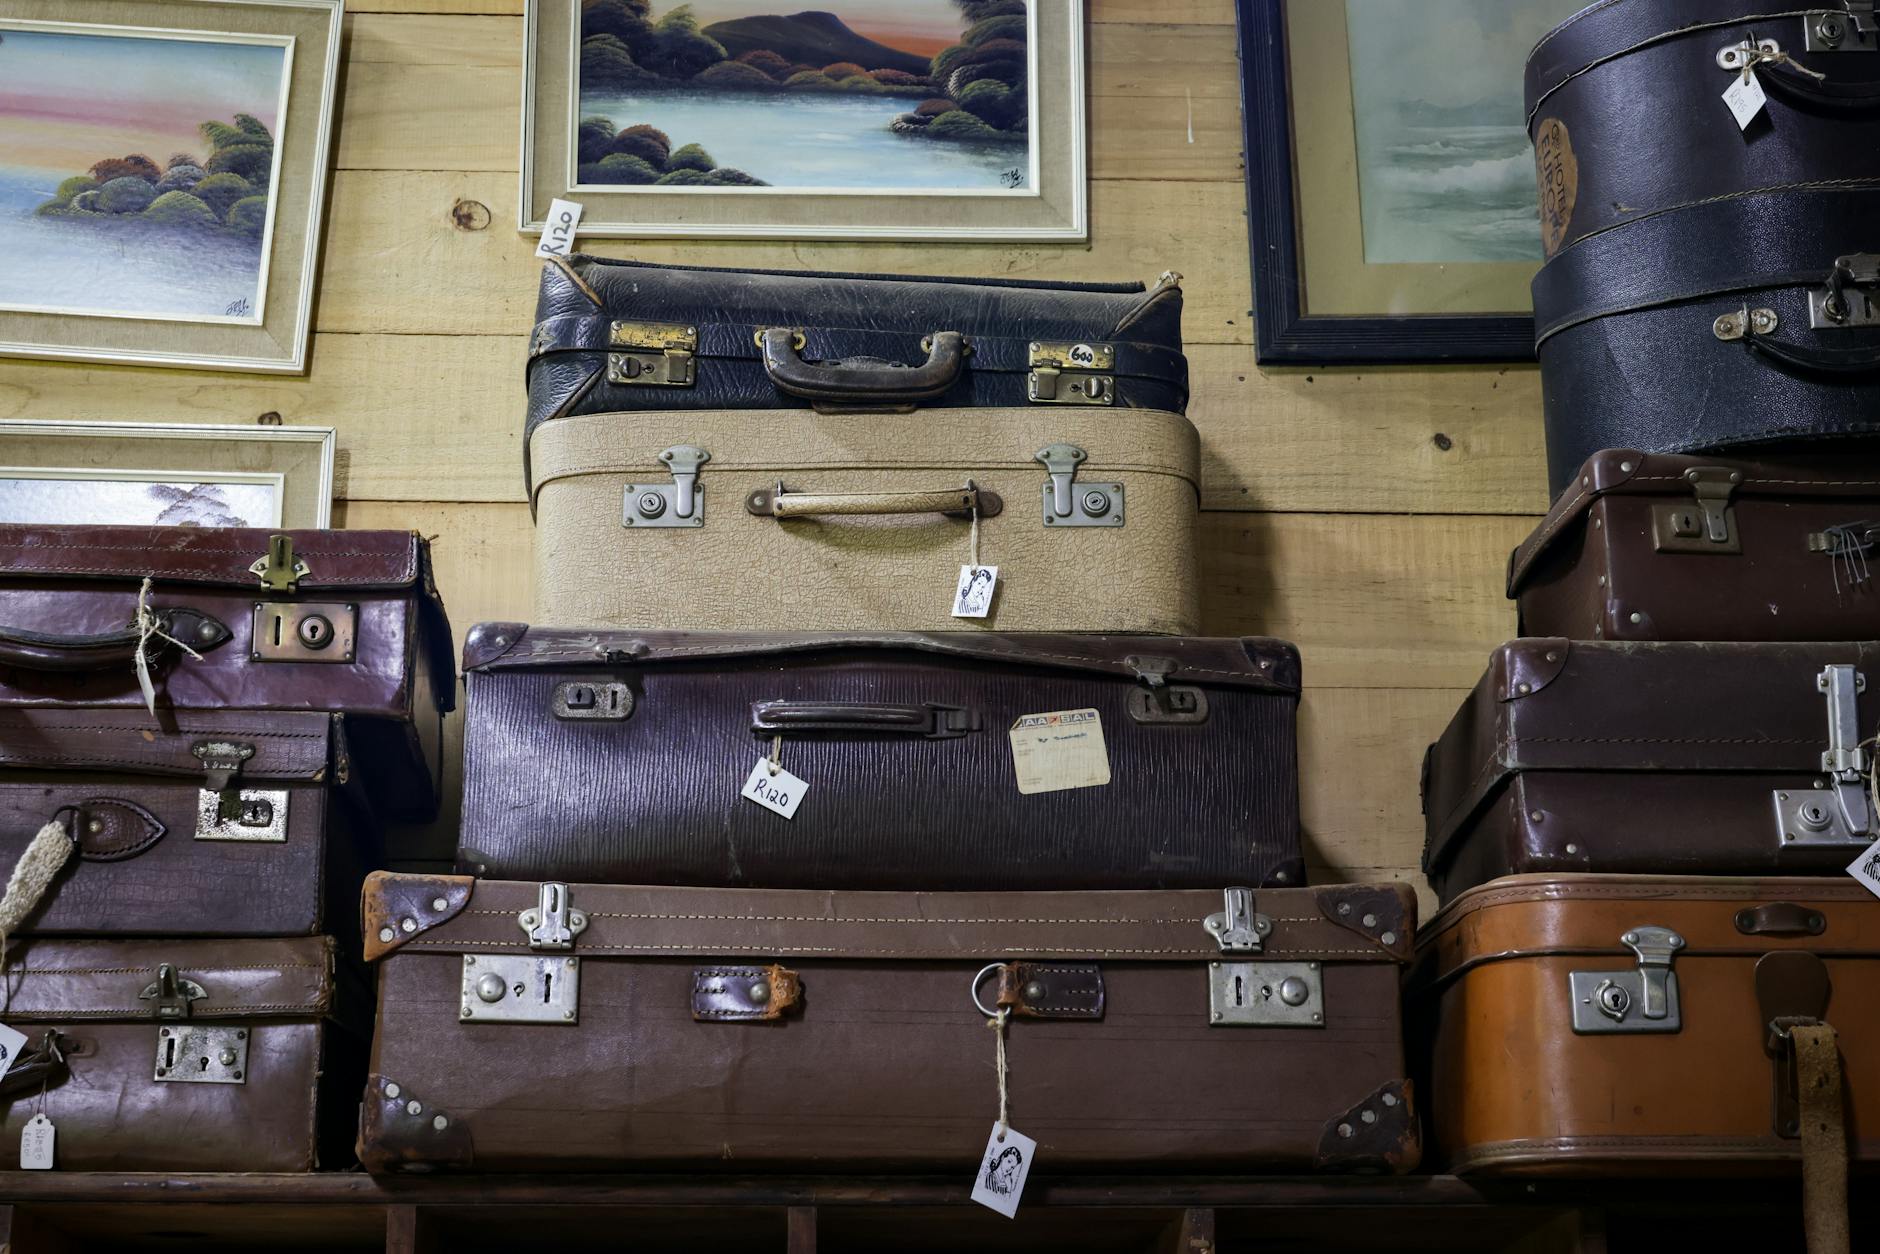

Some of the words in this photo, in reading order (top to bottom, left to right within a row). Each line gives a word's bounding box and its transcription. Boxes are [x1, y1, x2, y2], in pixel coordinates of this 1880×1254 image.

[541, 211, 572, 255] R120
[1071, 346, 1093, 363] 600
[1020, 716, 1048, 728] AA
[754, 778, 788, 807] R120
